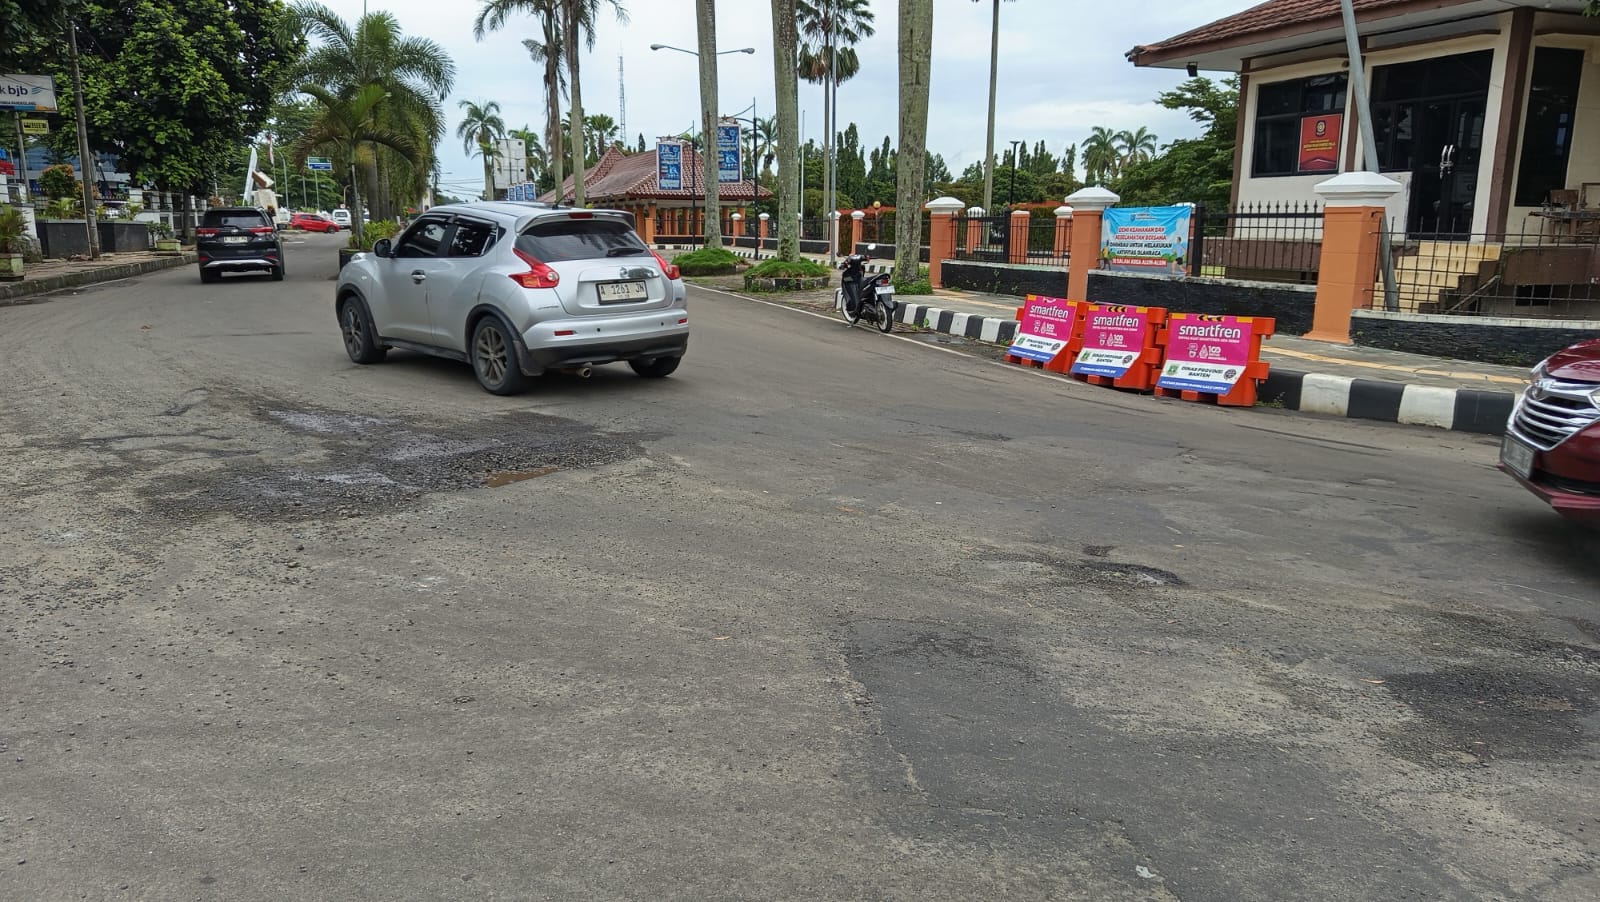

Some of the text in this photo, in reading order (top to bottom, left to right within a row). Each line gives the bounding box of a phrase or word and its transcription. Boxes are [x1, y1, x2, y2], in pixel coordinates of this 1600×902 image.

[8, 85, 28, 97] bjb
[600, 285, 606, 295] A
[610, 284, 630, 295] 1261
[1030, 305, 1069, 319] smartfren
[1092, 314, 1139, 327] smartfren
[1179, 324, 1241, 339] smartfren
